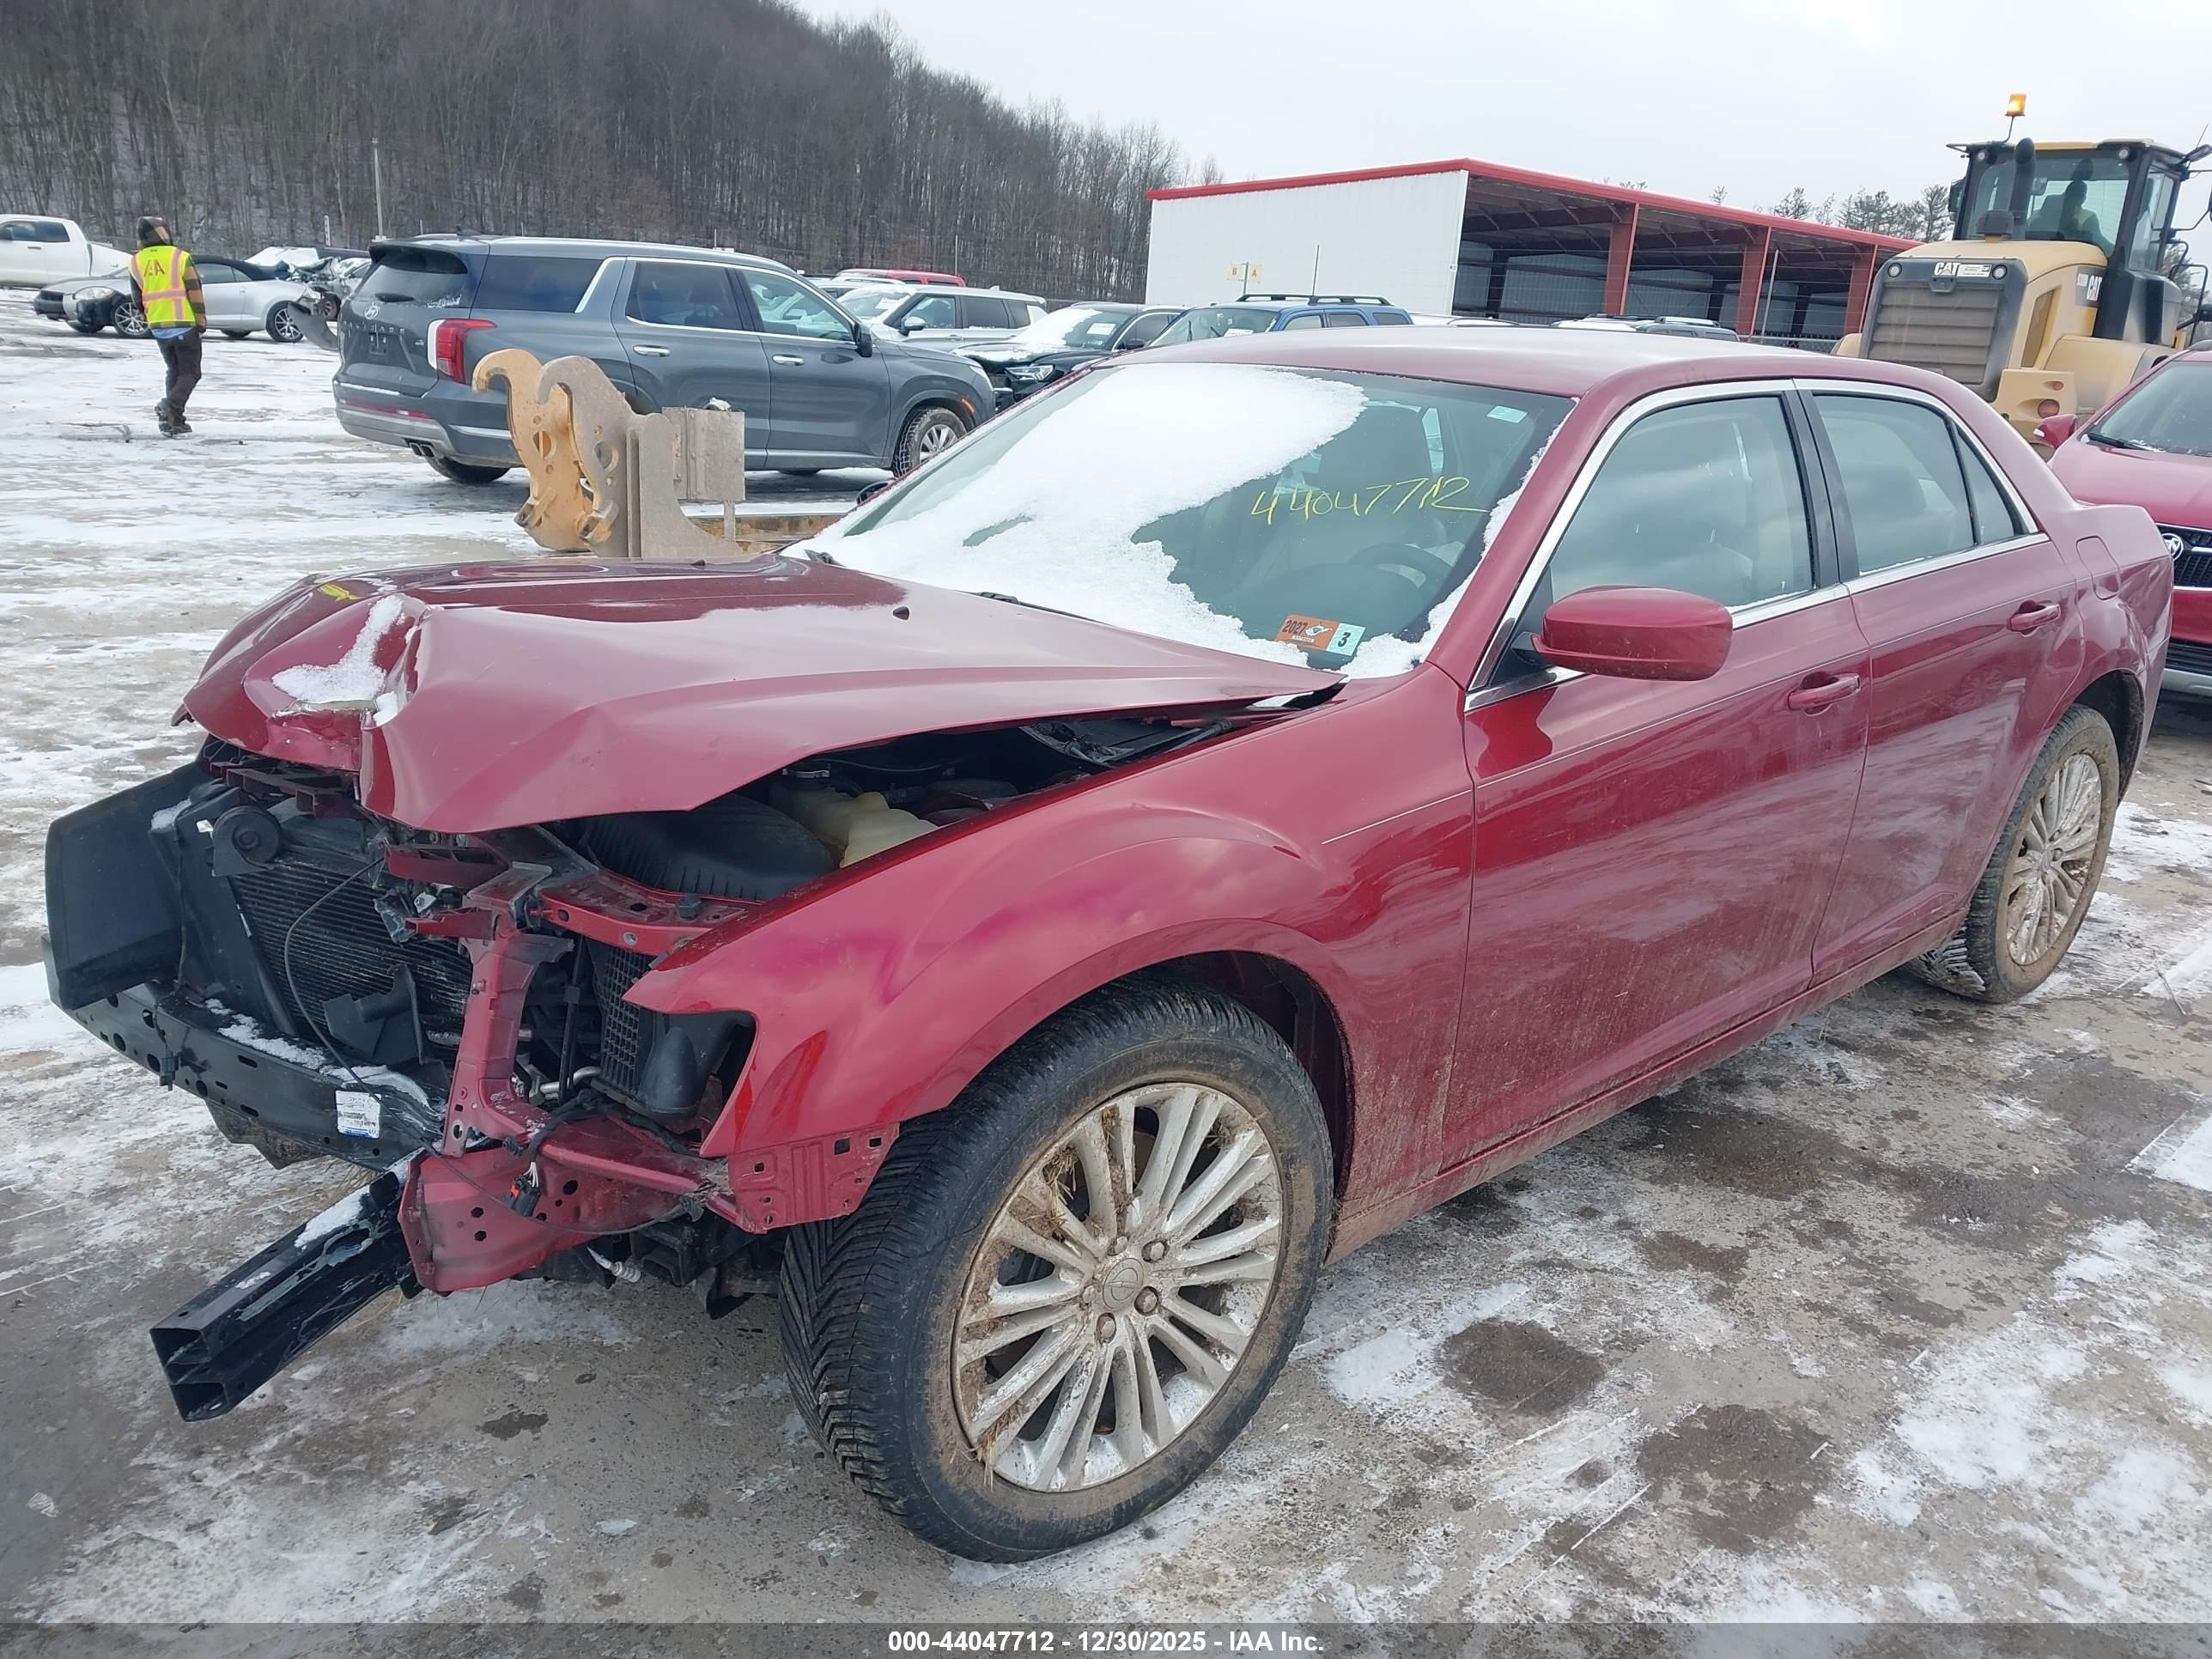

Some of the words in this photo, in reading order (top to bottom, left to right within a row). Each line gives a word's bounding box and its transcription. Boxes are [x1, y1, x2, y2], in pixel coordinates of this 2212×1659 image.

[1934, 262, 1961, 276] CAT
[2087, 274, 2103, 301] CAT
[1250, 476, 1491, 526] 44047712
[1282, 619, 1308, 635] 2027
[1337, 632, 1352, 647] 3
